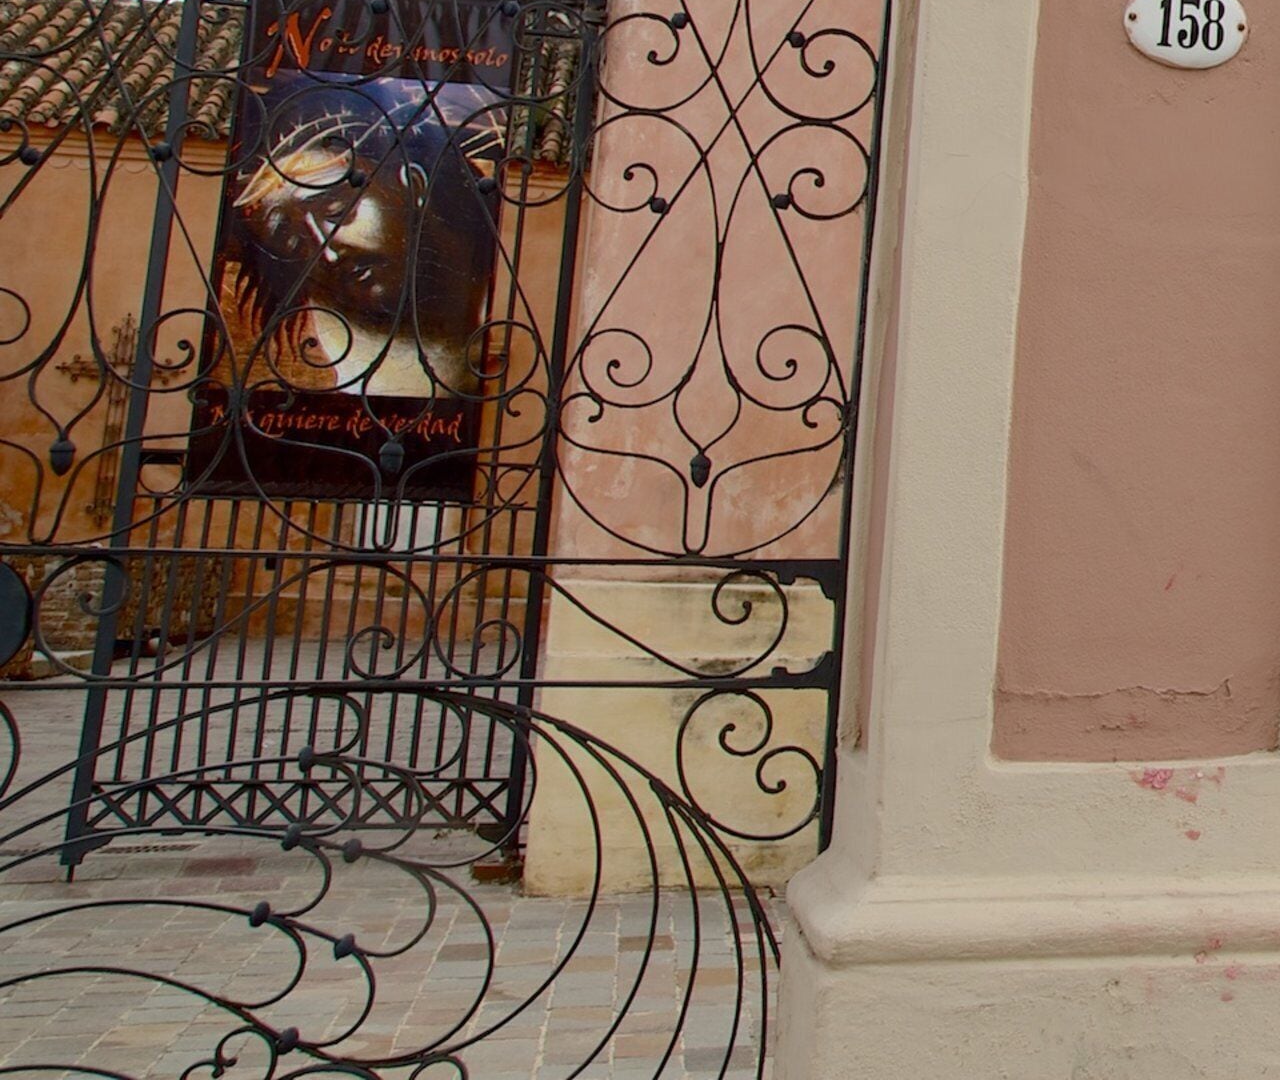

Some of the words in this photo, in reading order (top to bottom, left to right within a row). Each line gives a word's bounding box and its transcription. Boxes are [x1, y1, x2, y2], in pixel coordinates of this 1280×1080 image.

[266, 7, 333, 78] No
[466, 47, 509, 67] solo
[210, 404, 254, 428] Ns
[260, 406, 341, 438] quiere
[346, 408, 373, 439] de
